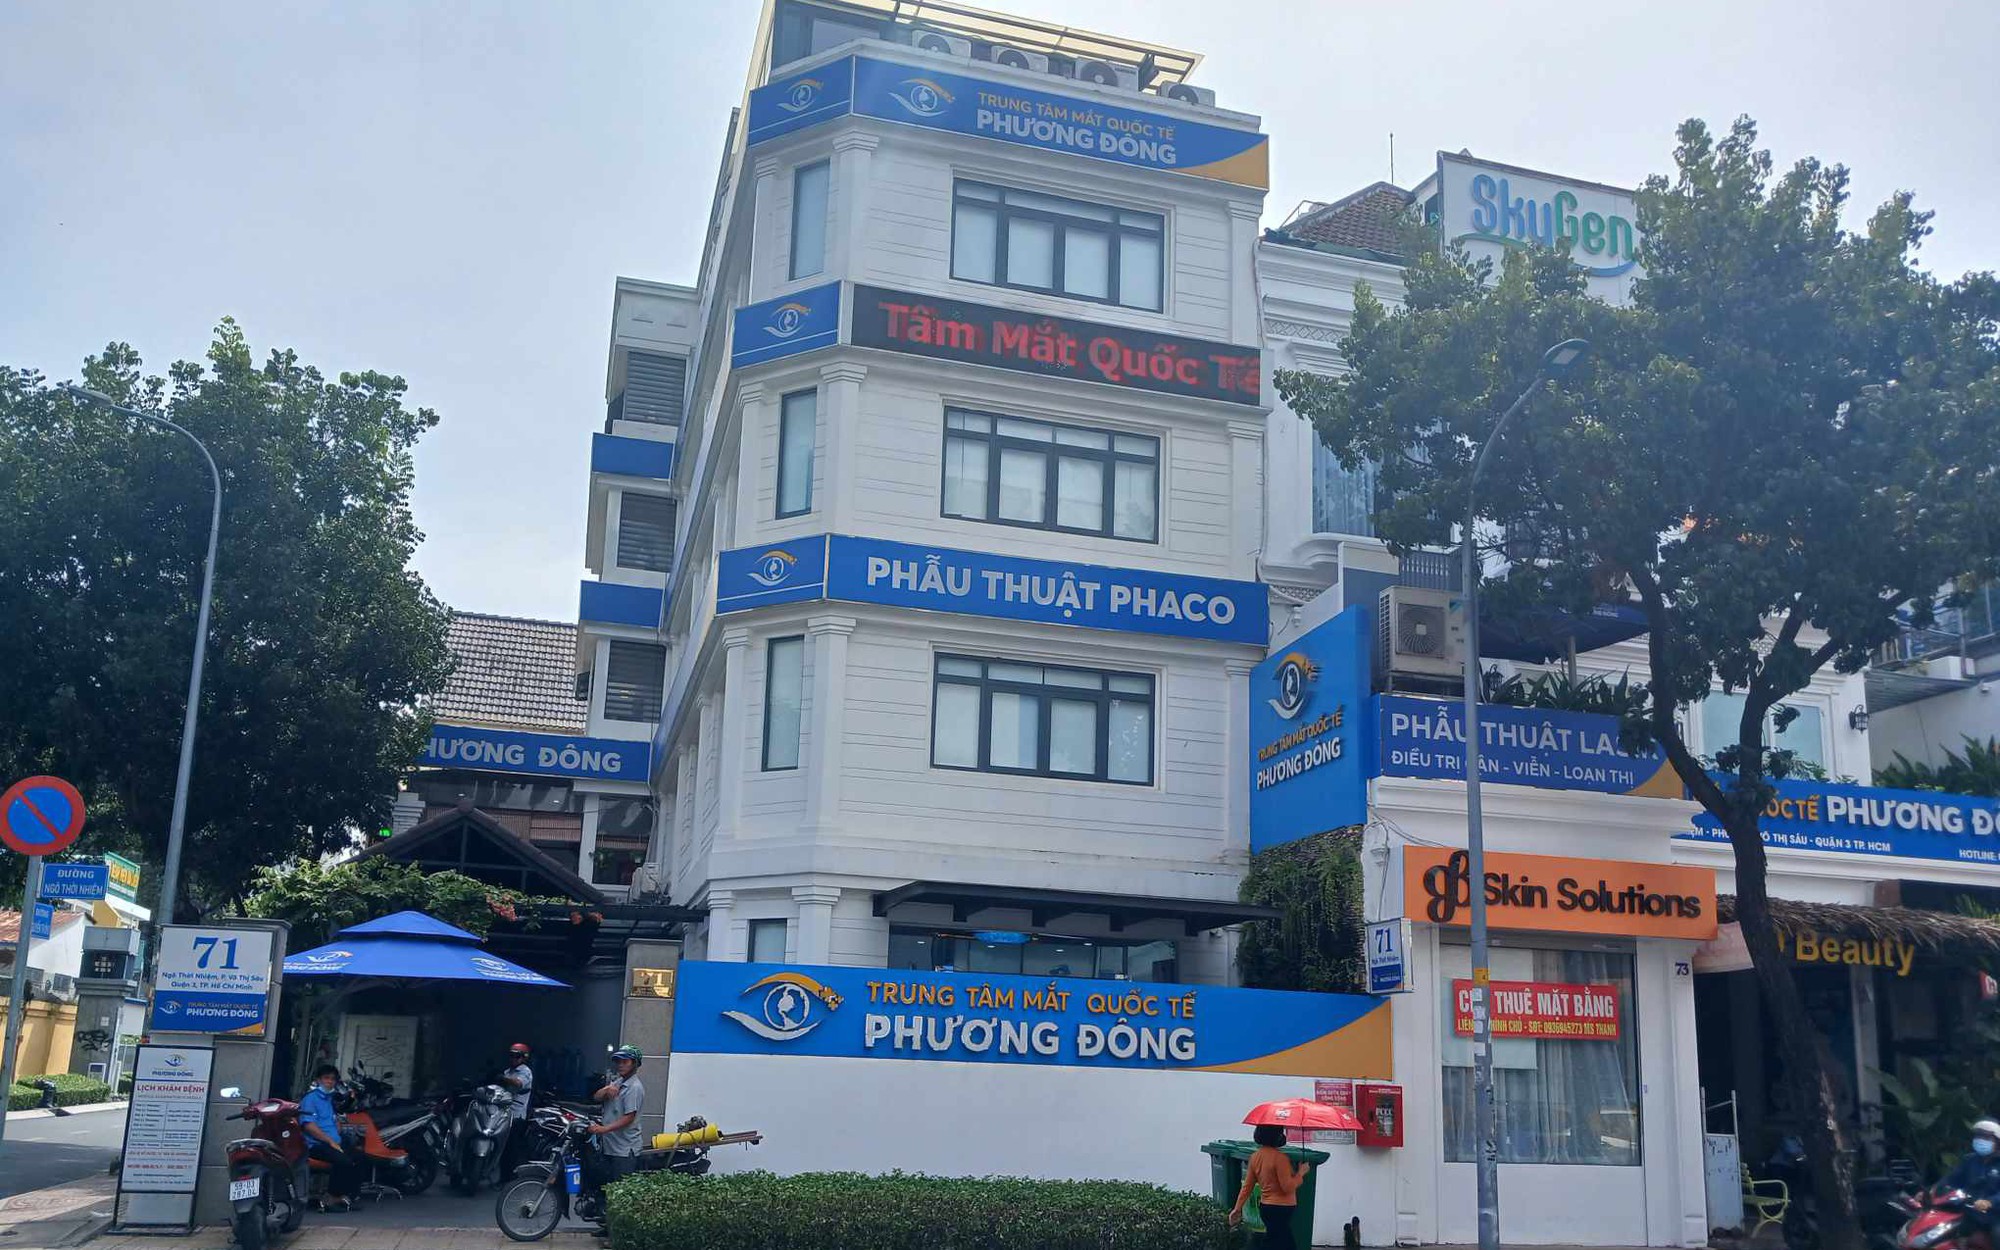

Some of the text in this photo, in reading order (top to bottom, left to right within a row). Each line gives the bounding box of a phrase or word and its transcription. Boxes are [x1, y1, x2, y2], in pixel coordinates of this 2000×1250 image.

[977, 92, 1177, 141] TRUNG TÂM MẮT QUỐC TẾ
[976, 109, 1177, 164] PHƯƠNG ĐÔNG
[1473, 174, 1636, 262] SkyGen
[879, 301, 976, 351] Tâm
[991, 318, 1078, 367] Mắt
[1088, 336, 1200, 384] Quốc
[867, 553, 1236, 625] PHẪU THUẬT PHACO
[424, 737, 621, 773] HƯƠNG ĐÔNG
[1258, 741, 1278, 762] TRUNG
[1480, 721, 1572, 757] THUẬT
[1256, 737, 1341, 791] PHƯƠNG ĐÔNG
[1391, 747, 1431, 767] ĐIỀU
[1435, 755, 1460, 774] TRỊ
[1465, 754, 1499, 776] ẬN
[1512, 756, 1550, 777] VIỄN
[1563, 765, 1605, 785] LOẠN
[1609, 770, 1634, 789] THỊ
[1796, 794, 1820, 821] TẾ
[1826, 795, 1963, 834] PHƯƠNG
[1972, 805, 2000, 835] Đ
[1773, 832, 1788, 845] THỊ
[1789, 832, 1807, 846] SÁU
[1815, 836, 1843, 850] QUẬN
[1845, 840, 1852, 849] 3
[1868, 841, 1891, 852] HCM
[44, 882, 60, 893] NGÔ
[62, 882, 78, 895] THỜI
[57, 868, 95, 879] ĐƯỜNG
[1483, 872, 1548, 908] Skin
[1557, 878, 1701, 919] Solutions
[193, 936, 240, 969] 71
[1375, 928, 1392, 953] 71
[1796, 932, 1915, 977] Beauty
[1675, 962, 1689, 977] 73
[186, 1008, 258, 1018] PHƯƠNG ĐÔNG
[867, 980, 1197, 1019] TRUNG TÂM MẮT QUỐC TẾ
[1494, 988, 1534, 1015] THUÊ
[1537, 988, 1569, 1020] MẶT
[1574, 986, 1614, 1018] BẰNG
[865, 1013, 1196, 1060] PHƯƠNG ĐÔNG
